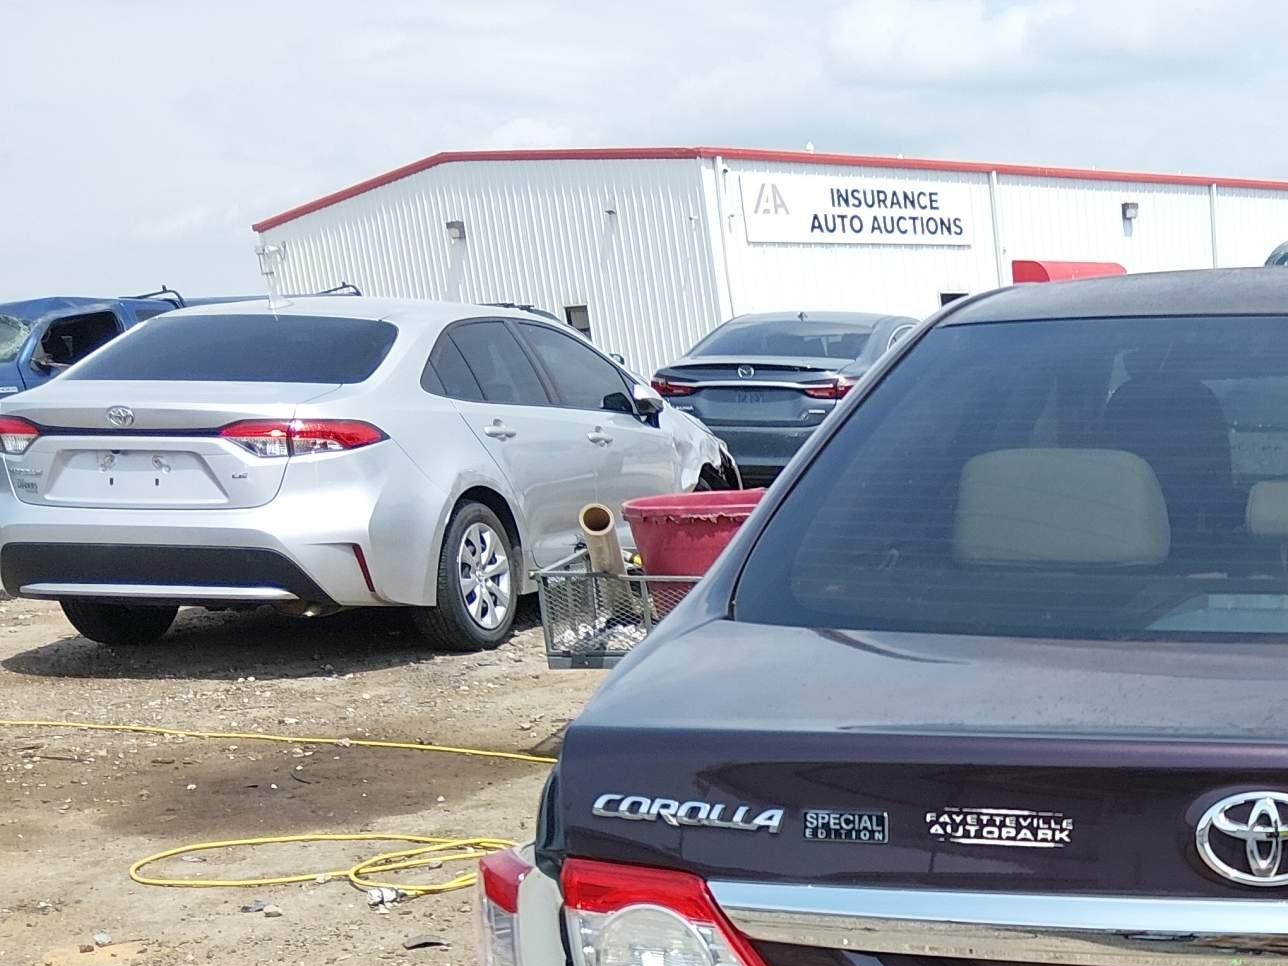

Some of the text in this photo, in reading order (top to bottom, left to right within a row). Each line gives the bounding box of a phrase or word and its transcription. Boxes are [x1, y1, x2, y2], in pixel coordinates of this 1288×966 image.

[830, 188, 940, 210] INSURANCE
[810, 214, 964, 236] AUTO AUCTIONS
[592, 793, 785, 834] COROLLA
[805, 813, 883, 831] SPECIAL
[925, 812, 1074, 831] FAYETTEVILLE
[805, 828, 884, 841] EDITION
[929, 824, 1072, 843] AUTOPARK
